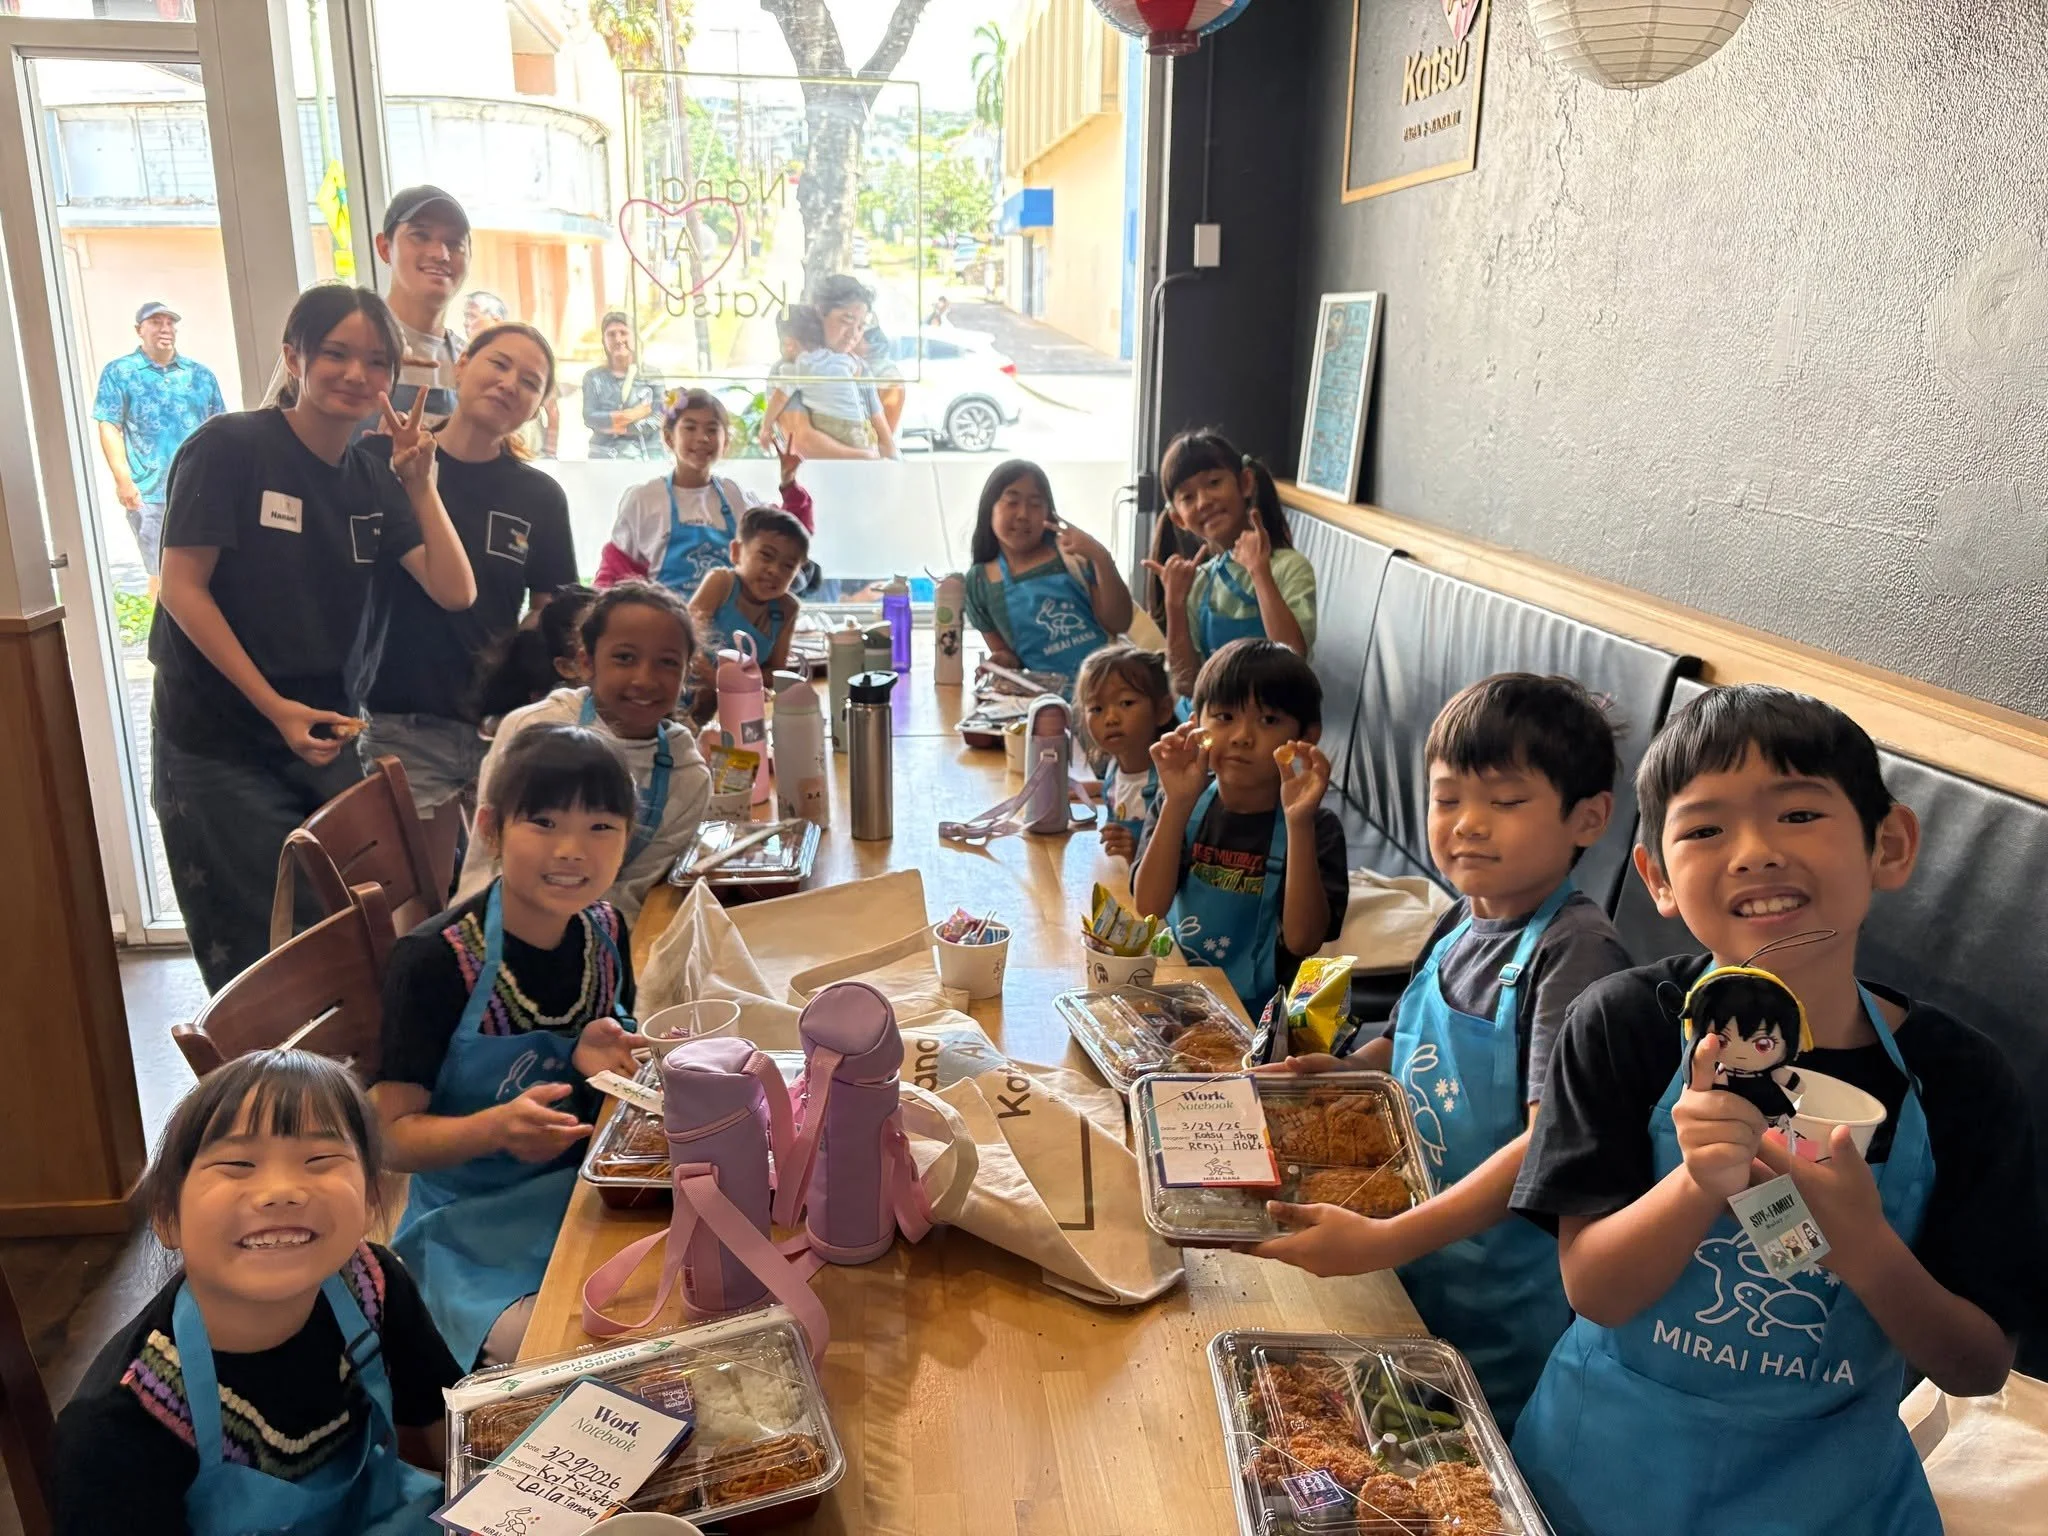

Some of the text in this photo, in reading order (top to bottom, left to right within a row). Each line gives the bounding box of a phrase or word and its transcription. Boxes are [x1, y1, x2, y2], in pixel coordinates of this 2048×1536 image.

[1402, 40, 1468, 106] Katsu
[914, 1037, 940, 1092] ana
[1177, 1100, 1234, 1111] Notebook
[1181, 1091, 1226, 1101] Work
[572, 1350, 637, 1373] BAMBOO
[1653, 1319, 1749, 1372] MIRAI
[571, 1416, 638, 1453] Notebook
[593, 1405, 643, 1438] Work
[509, 1455, 539, 1474] Program:
[522, 1442, 542, 1454] Date:
[494, 1469, 517, 1485] Name:
[516, 1474, 565, 1504] Leila
